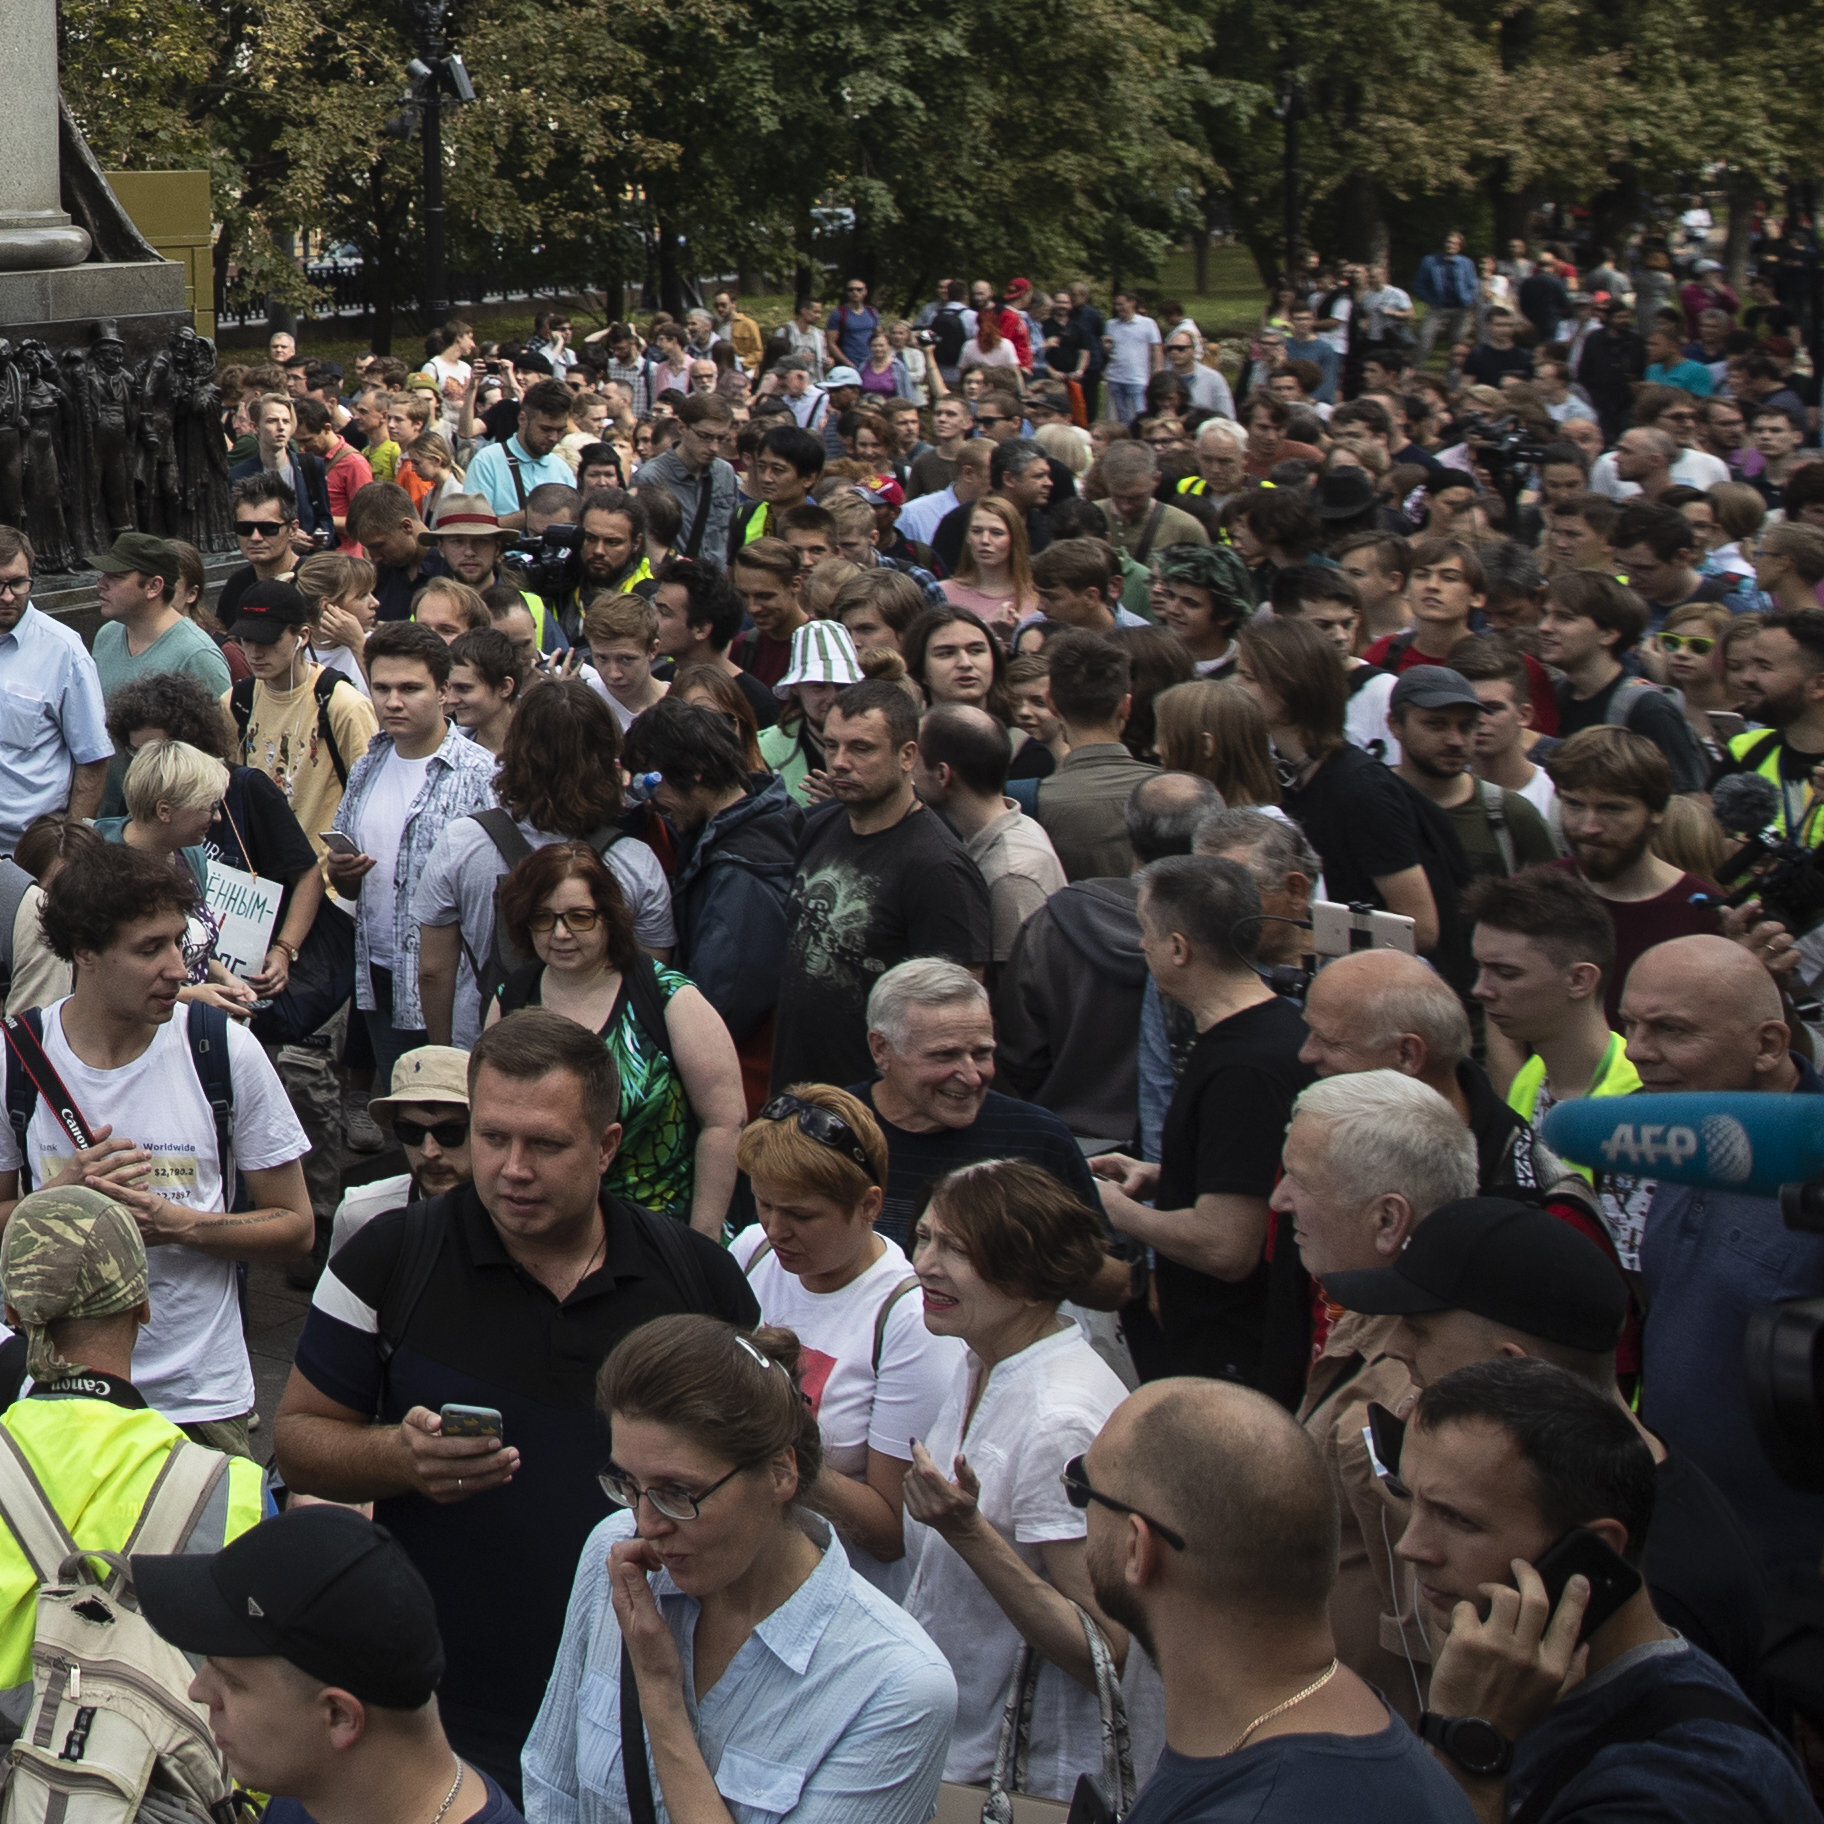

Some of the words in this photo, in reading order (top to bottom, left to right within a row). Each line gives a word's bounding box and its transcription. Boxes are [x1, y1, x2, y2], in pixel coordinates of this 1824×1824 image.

[143, 1142, 196, 1152] Worldwide
[1600, 1123, 1698, 1165] AFP
[51, 1378, 111, 1396] Canon
